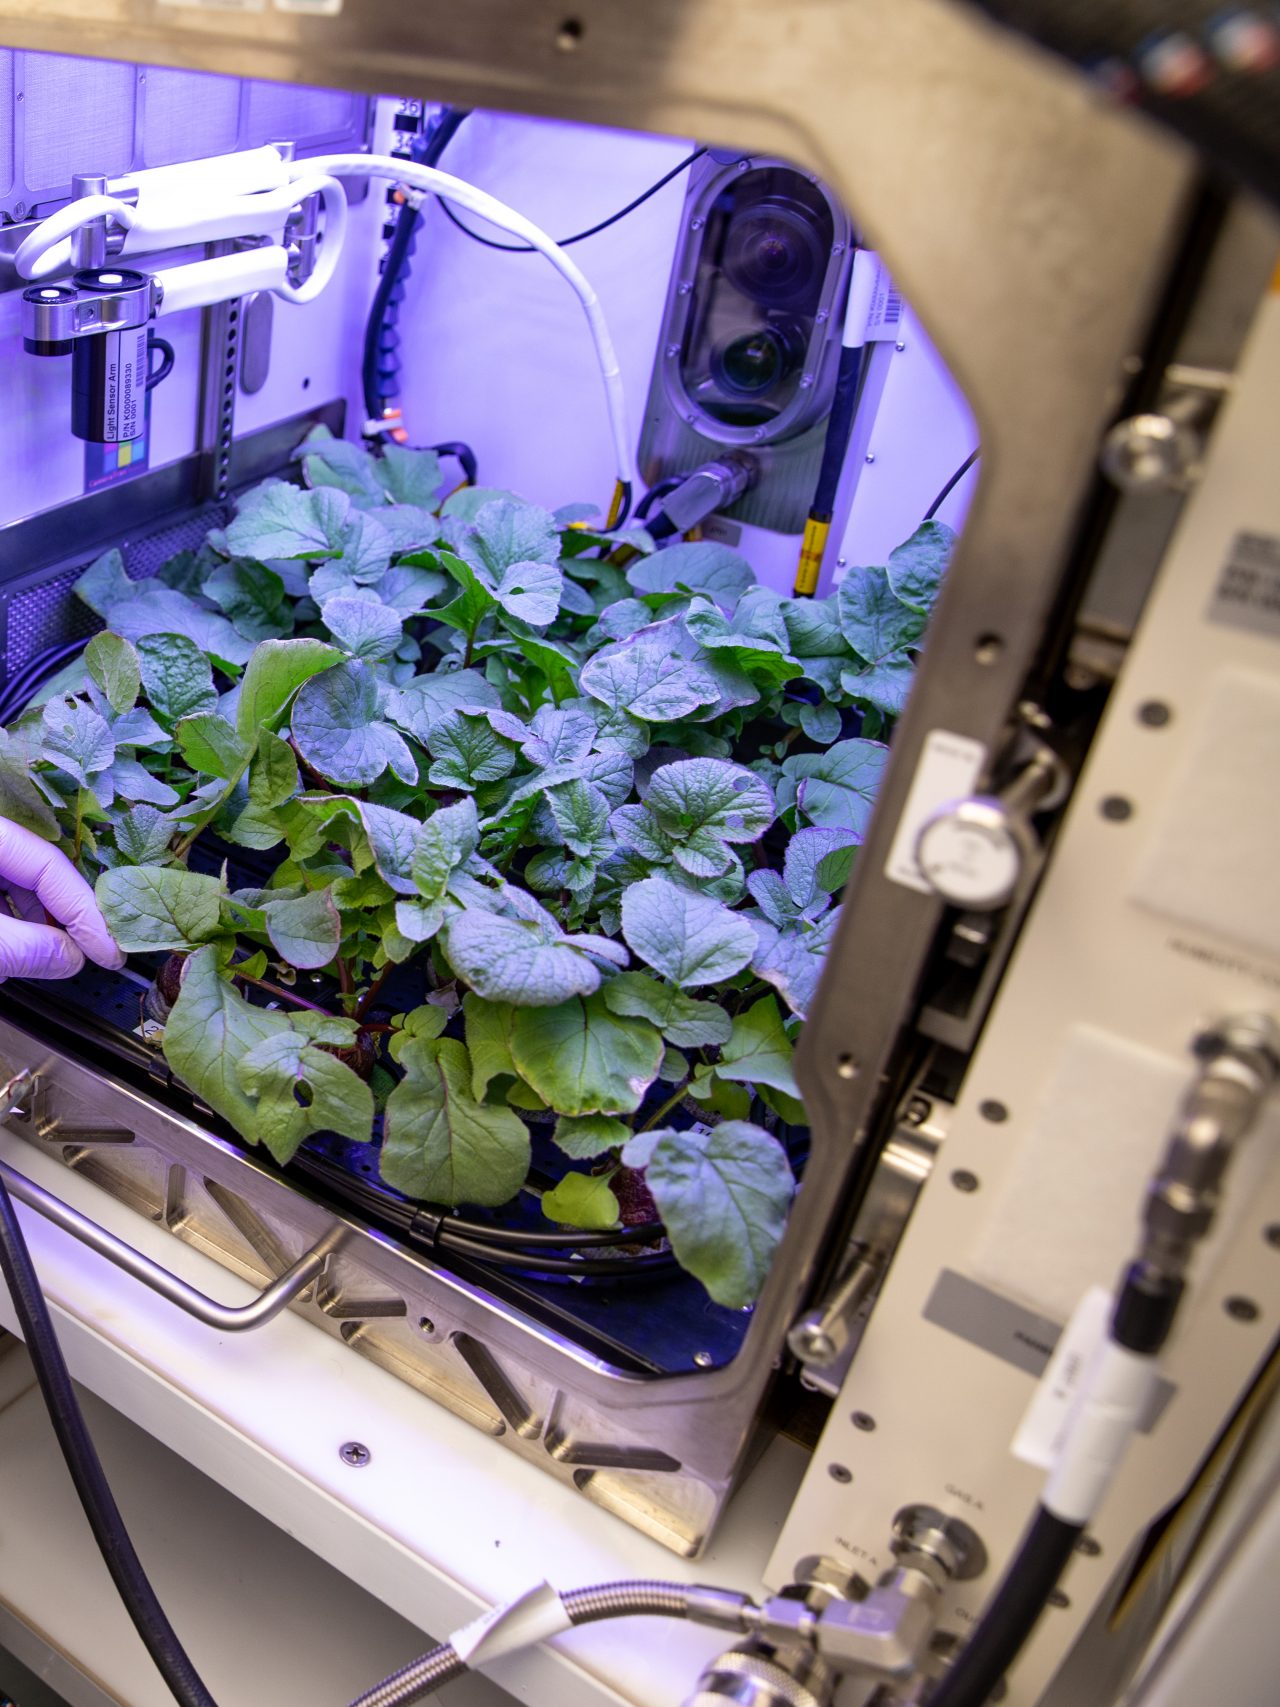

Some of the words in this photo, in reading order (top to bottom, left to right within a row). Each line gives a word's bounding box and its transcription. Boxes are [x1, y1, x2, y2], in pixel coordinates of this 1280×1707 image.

[108, 363, 117, 382] Arm
[107, 384, 116, 416] Sensor
[106, 417, 117, 440] Light
